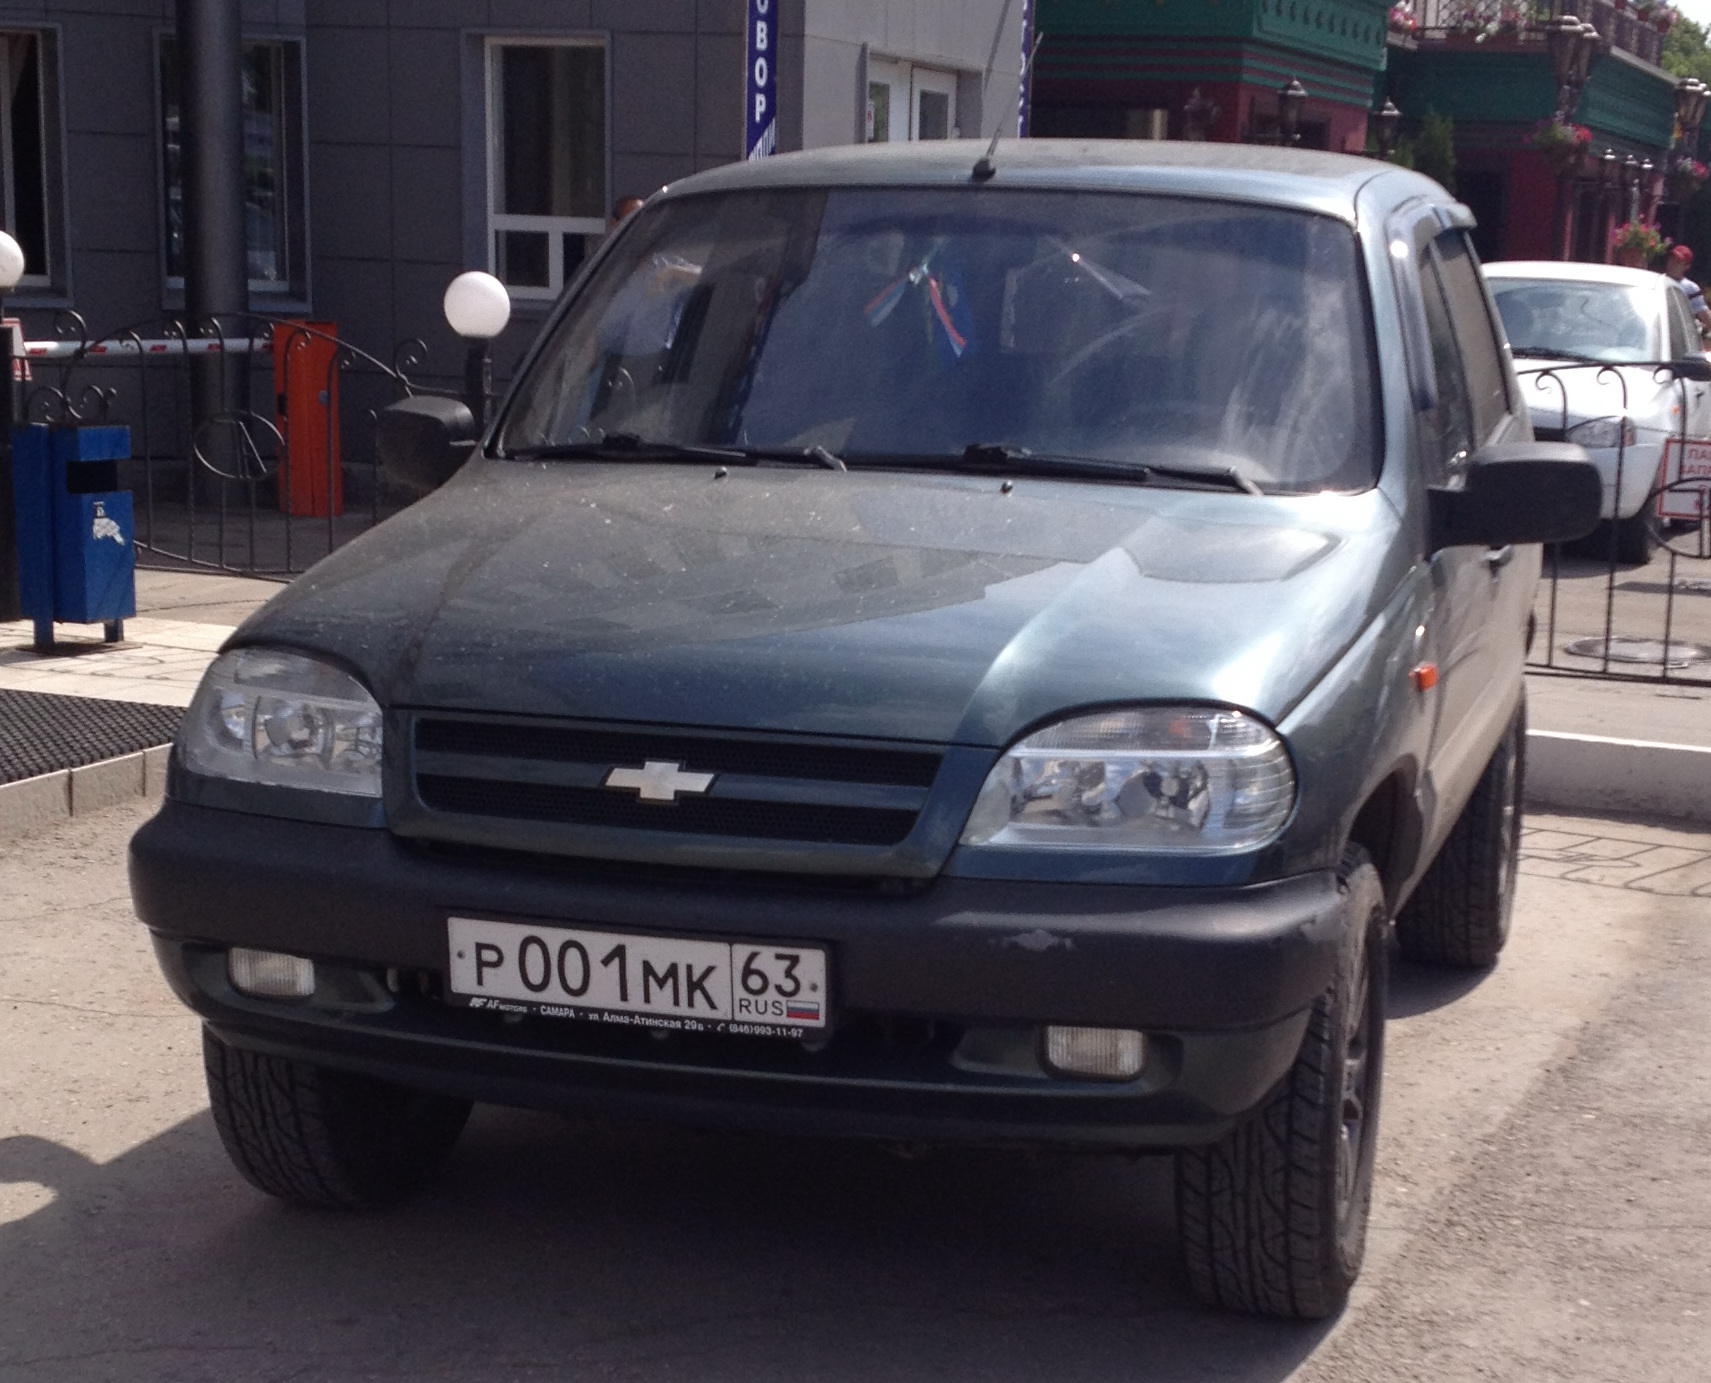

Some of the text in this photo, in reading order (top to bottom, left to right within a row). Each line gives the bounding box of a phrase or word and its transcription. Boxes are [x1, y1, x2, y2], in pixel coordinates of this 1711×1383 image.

[475, 935, 801, 1010] Р001МК 63
[540, 1005, 576, 1018] САМАРА
[602, 1011, 682, 1029] Алма-Атинская
[739, 998, 784, 1016] RUS
